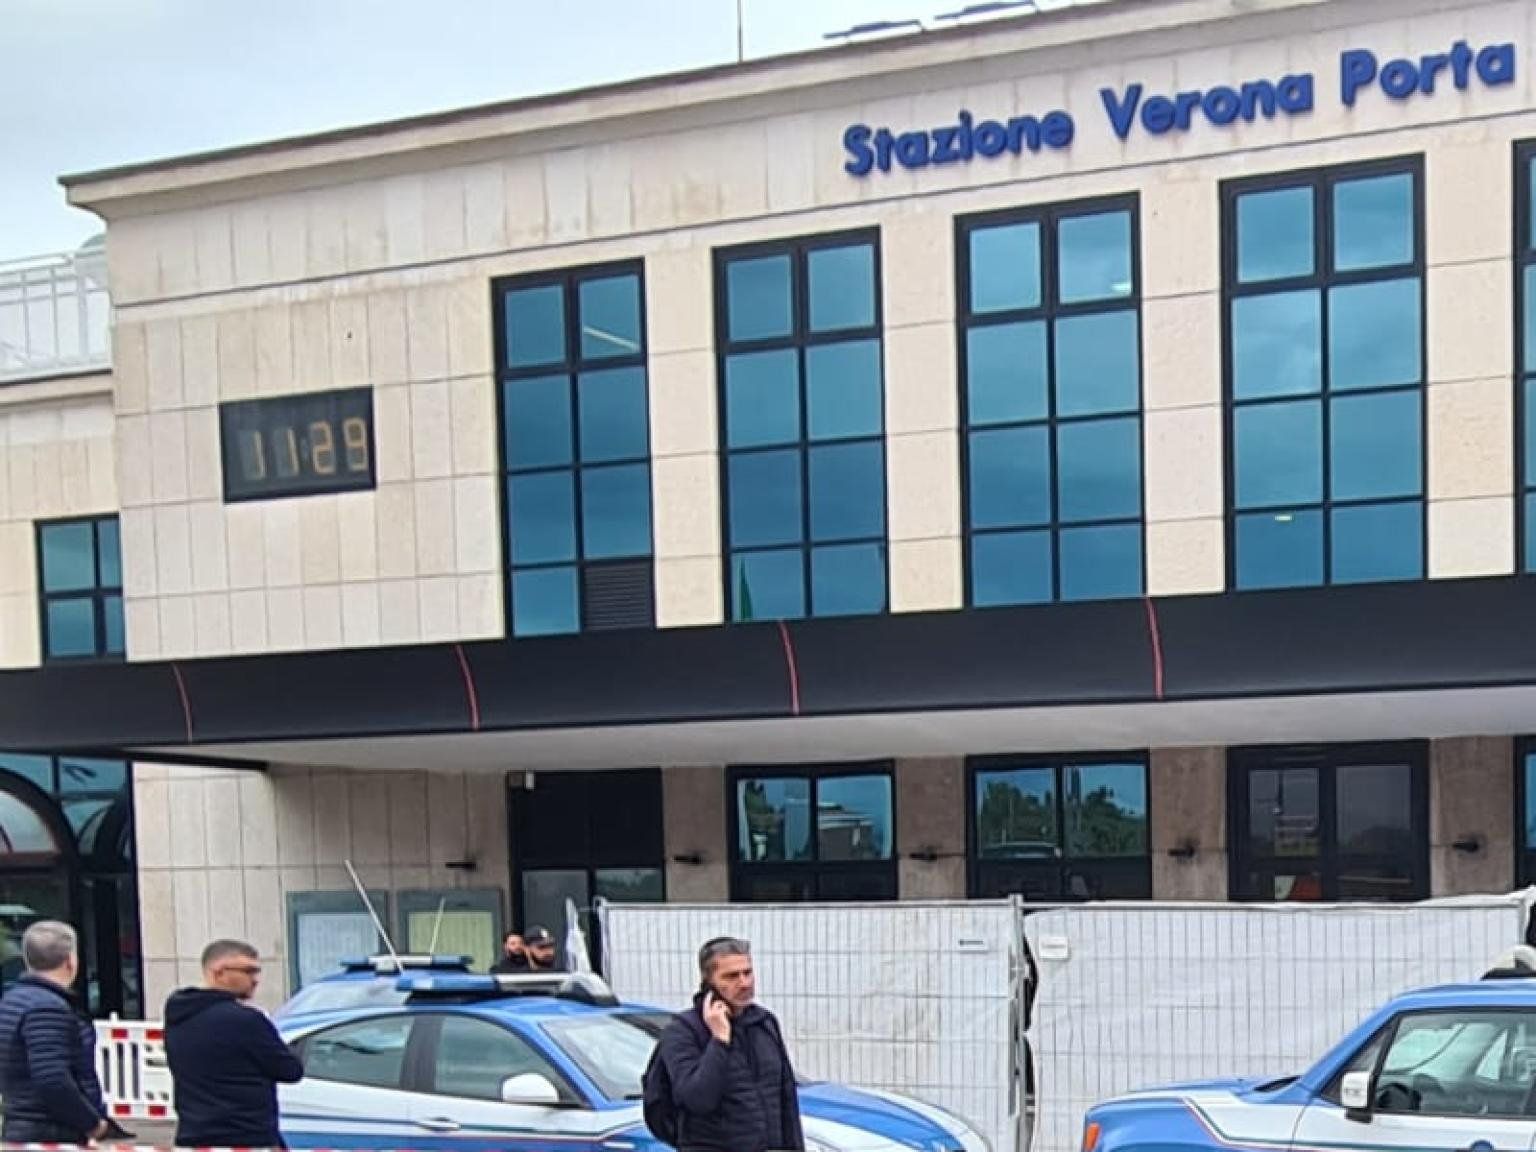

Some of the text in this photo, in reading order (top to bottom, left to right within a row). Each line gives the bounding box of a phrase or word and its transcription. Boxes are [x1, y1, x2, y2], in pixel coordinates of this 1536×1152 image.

[843, 107, 1076, 177] Stazione
[1100, 72, 1315, 142] Verona
[1340, 39, 1516, 109] Porta
